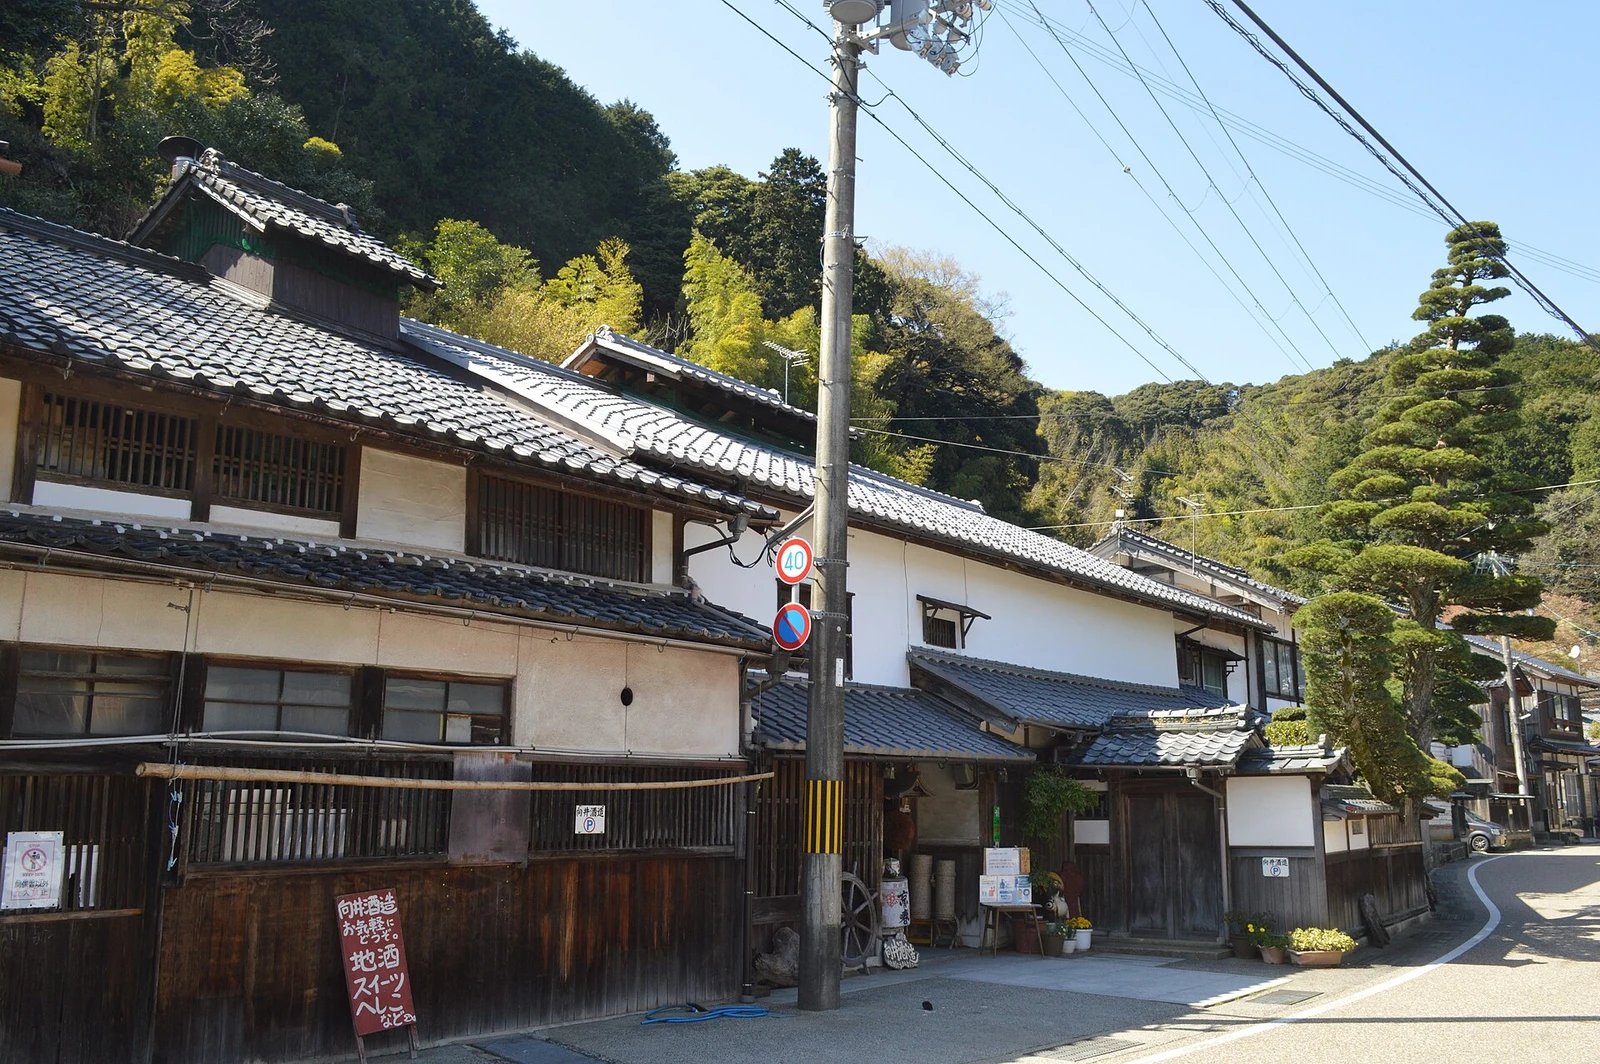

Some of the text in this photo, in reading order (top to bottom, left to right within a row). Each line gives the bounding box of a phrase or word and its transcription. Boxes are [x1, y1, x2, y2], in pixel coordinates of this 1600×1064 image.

[784, 551, 804, 571] 40
[577, 806, 603, 817] 向井酒造
[587, 820, 593, 830] P
[338, 892, 397, 919] 向井酒造
[343, 916, 394, 936] お気軽に
[349, 943, 400, 972] 地酒
[353, 972, 405, 1000] スイーツ
[356, 993, 403, 1016] へしこ
[381, 1011, 405, 1028] など
